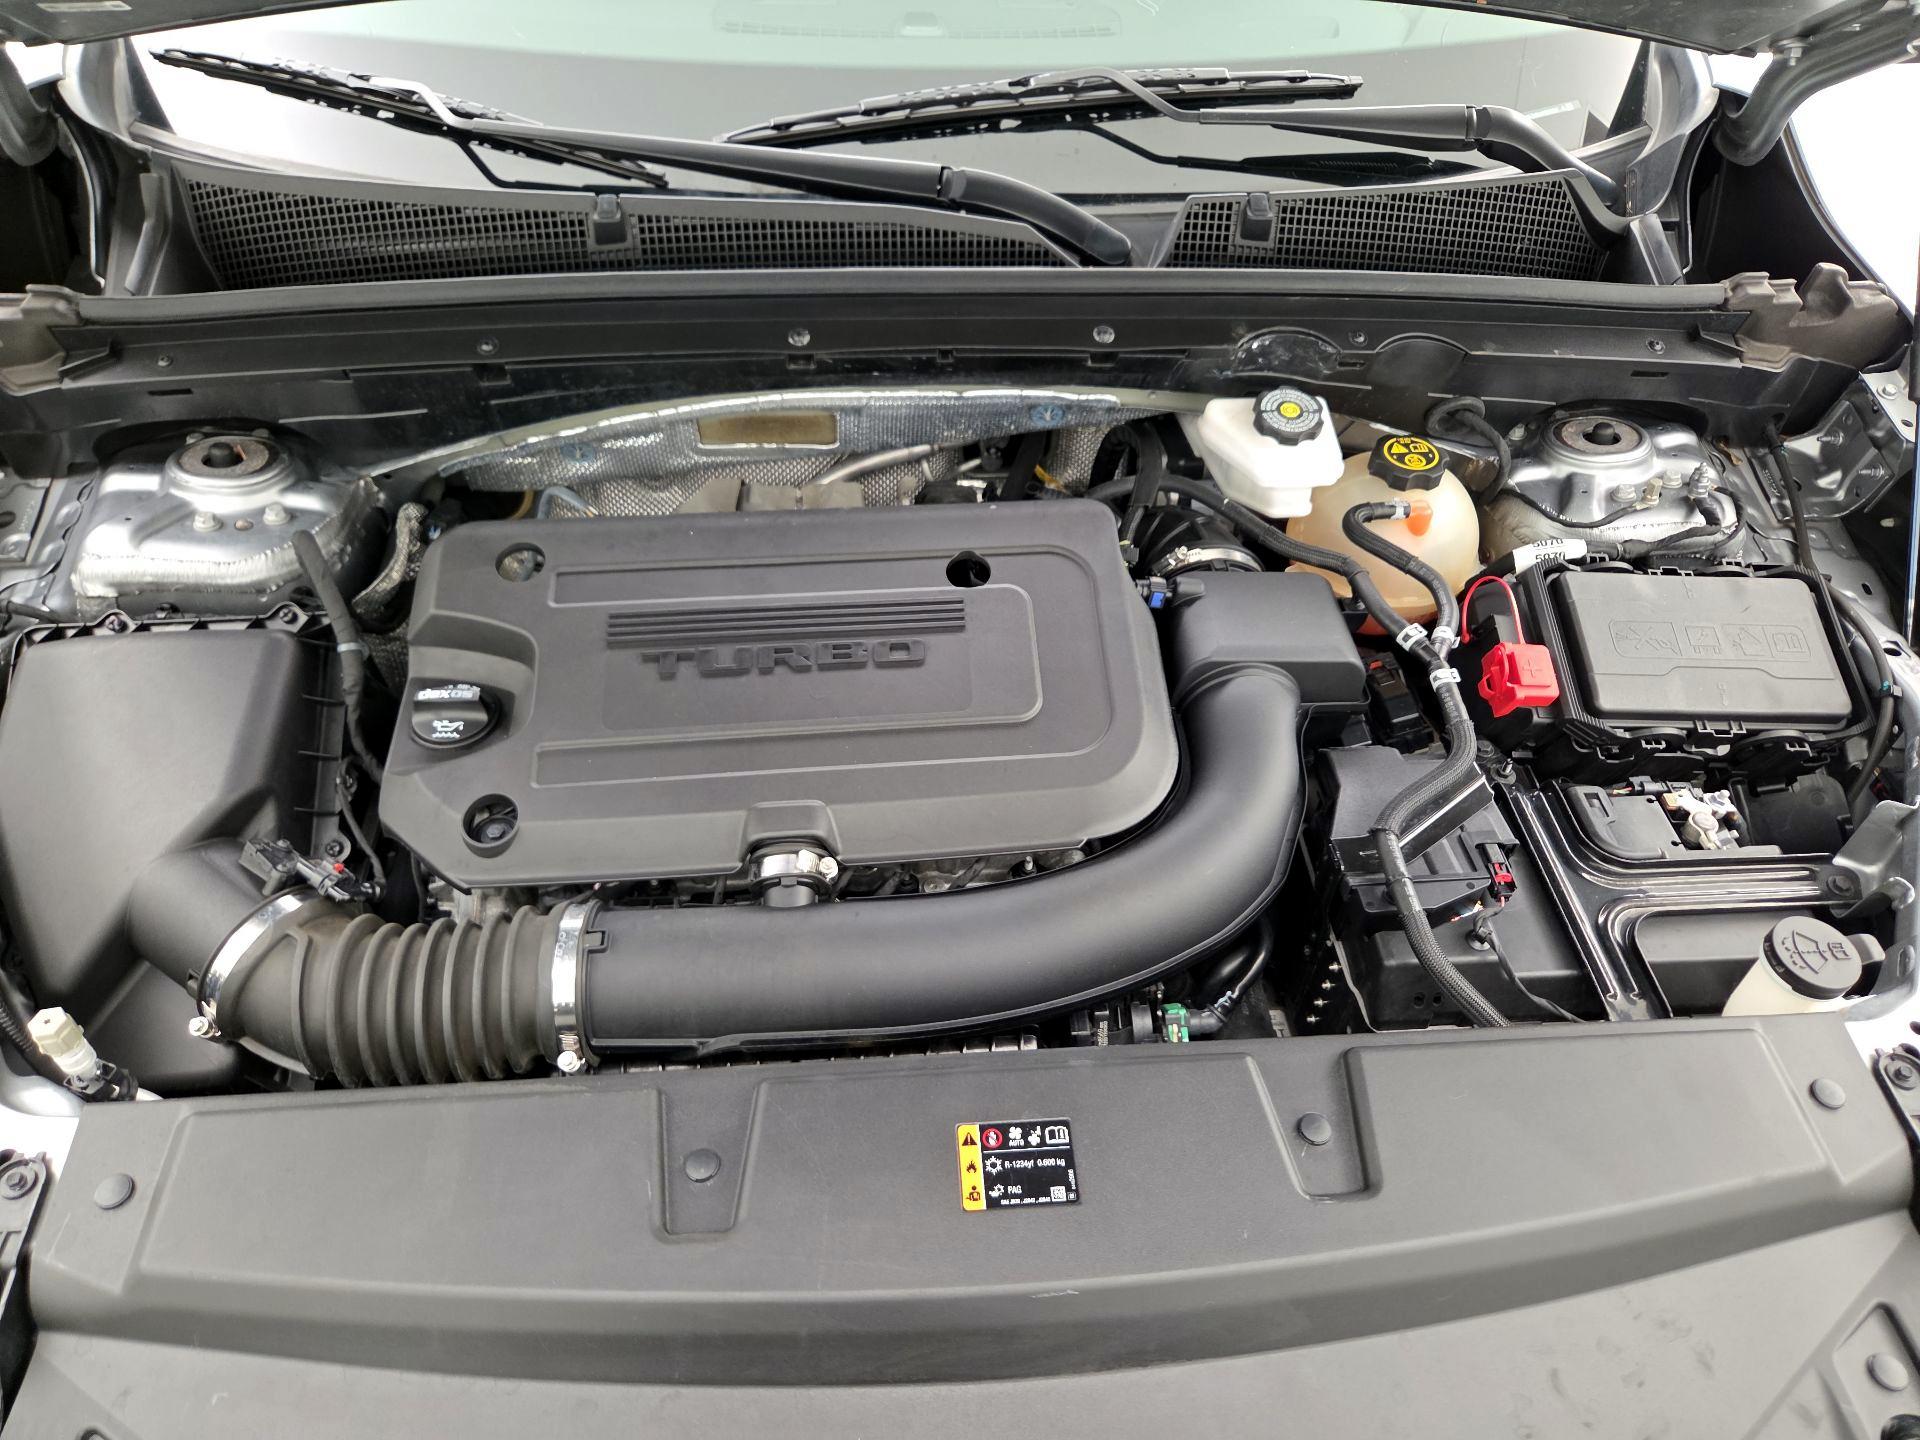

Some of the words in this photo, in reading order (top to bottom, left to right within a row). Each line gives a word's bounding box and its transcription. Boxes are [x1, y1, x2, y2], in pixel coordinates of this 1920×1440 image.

[640, 640, 926, 680] TURBO
[417, 688, 474, 700] dexos
[1037, 1158, 1055, 1167] 0.600
[1056, 1158, 1065, 1167] kg
[1007, 1185, 1022, 1194] PAG
